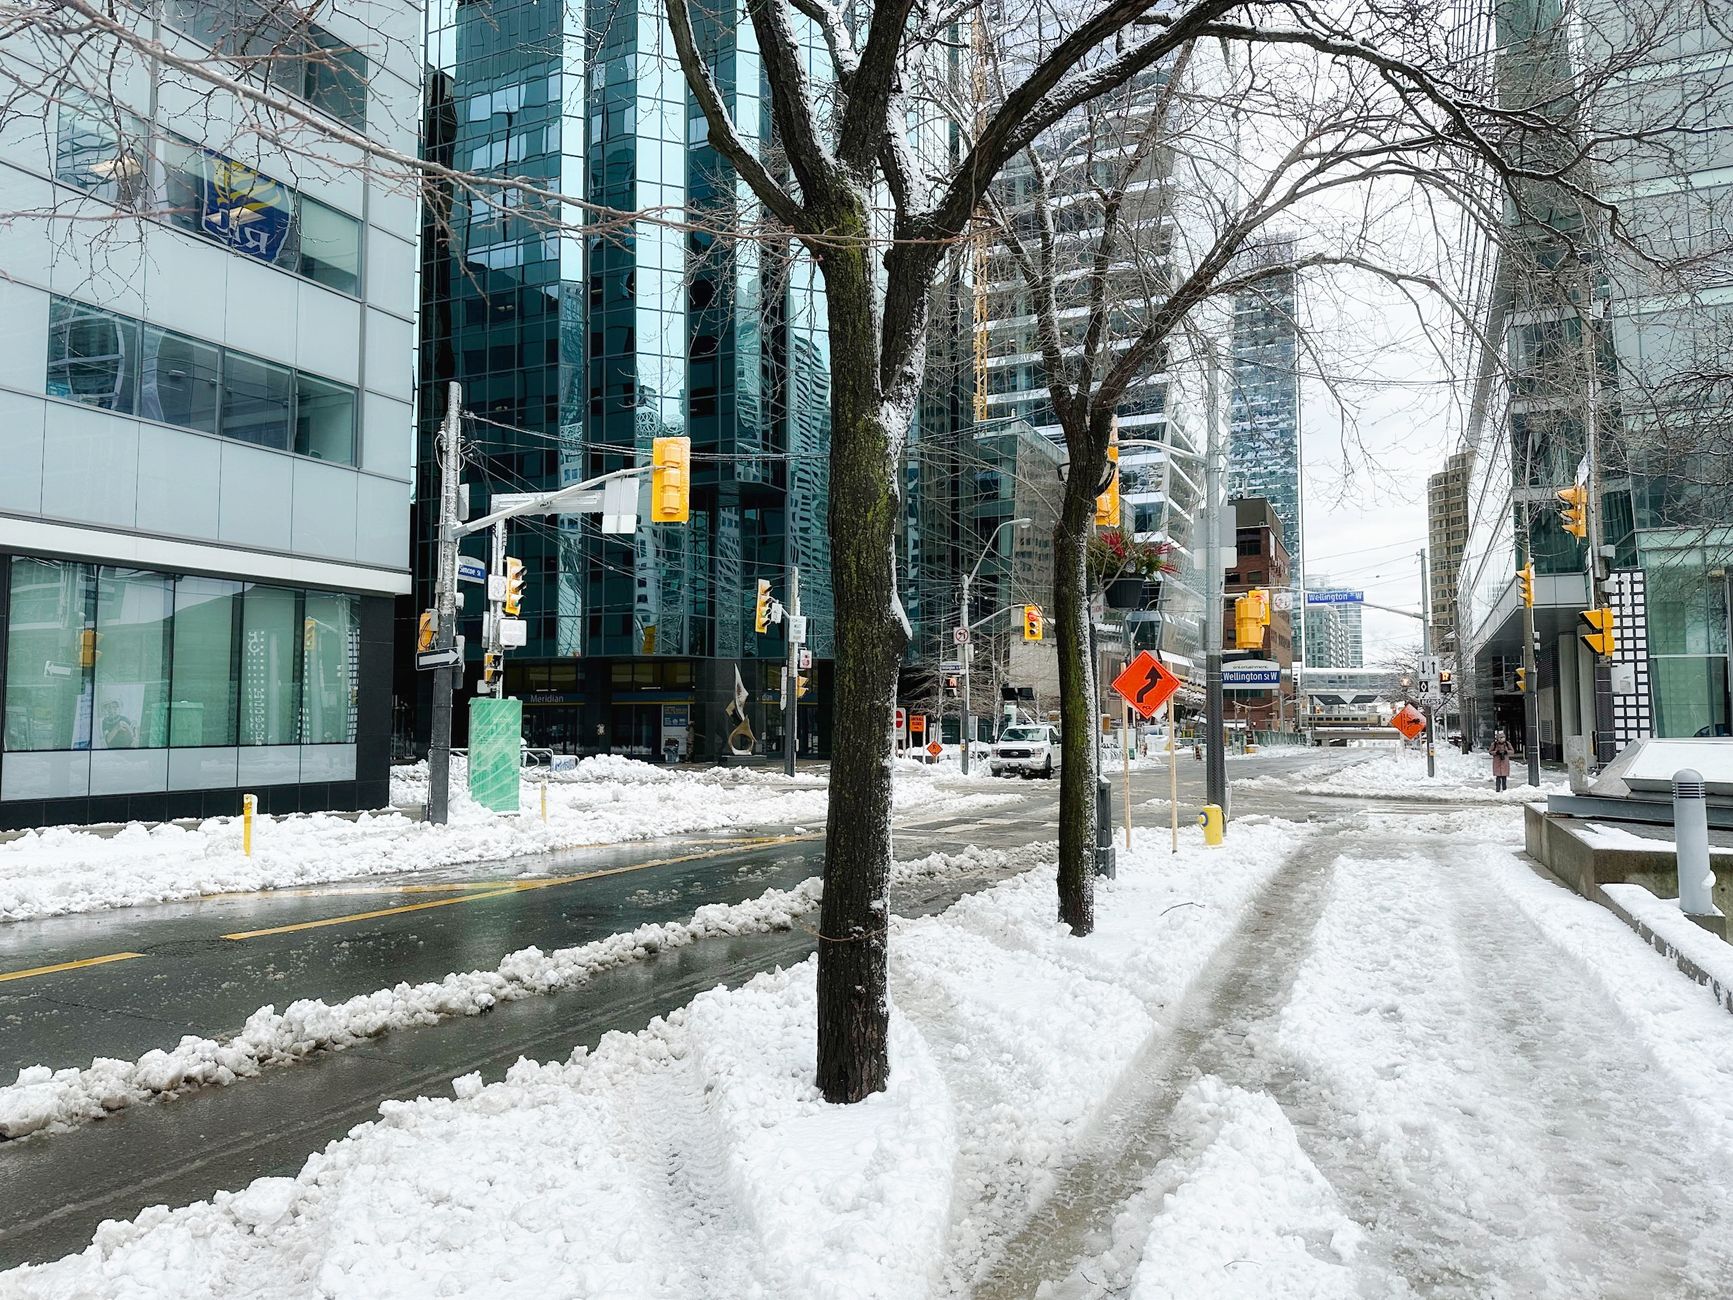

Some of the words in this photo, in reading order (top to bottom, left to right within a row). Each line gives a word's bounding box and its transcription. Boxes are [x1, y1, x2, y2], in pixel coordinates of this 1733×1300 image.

[1308, 592, 1348, 603] Wellington
[1355, 591, 1363, 600] W
[1223, 672, 1262, 683] Wellington
[1270, 672, 1278, 681] W
[530, 694, 564, 703] Meridian
